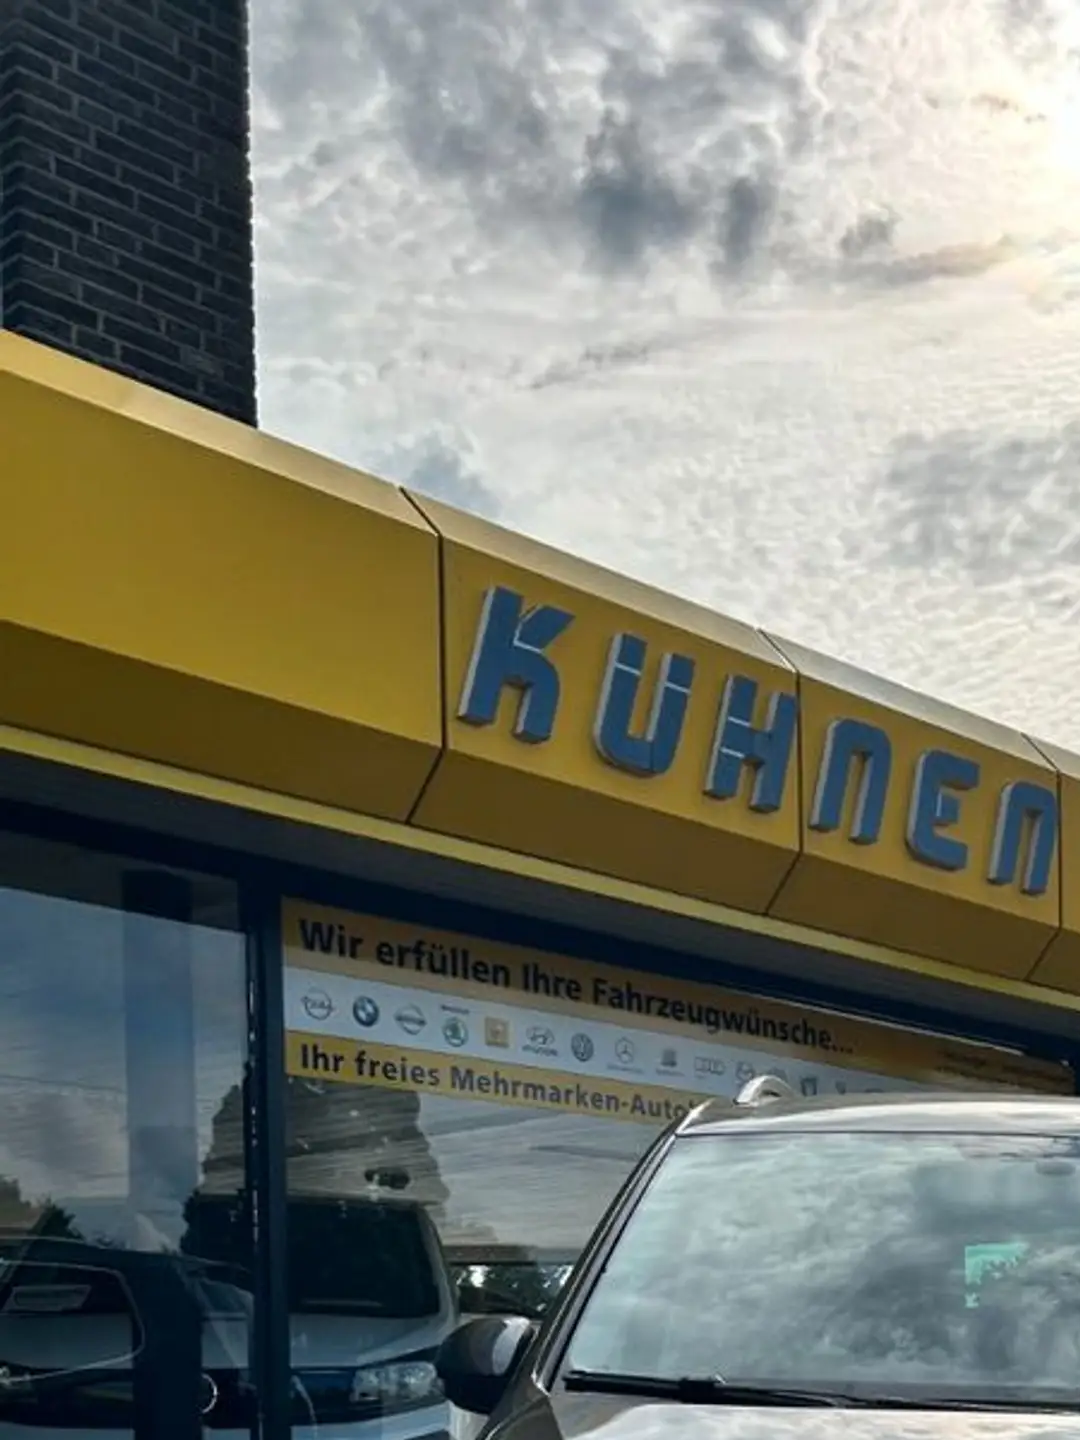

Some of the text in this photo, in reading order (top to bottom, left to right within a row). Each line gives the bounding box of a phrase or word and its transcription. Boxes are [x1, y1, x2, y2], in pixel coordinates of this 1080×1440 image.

[456, 585, 1059, 896] KÜHNEN
[299, 918, 854, 1054] Wir erfüllen Ihre Fahrzeugwünsche...
[301, 1042, 344, 1073] Ihr
[355, 1048, 440, 1088] freies
